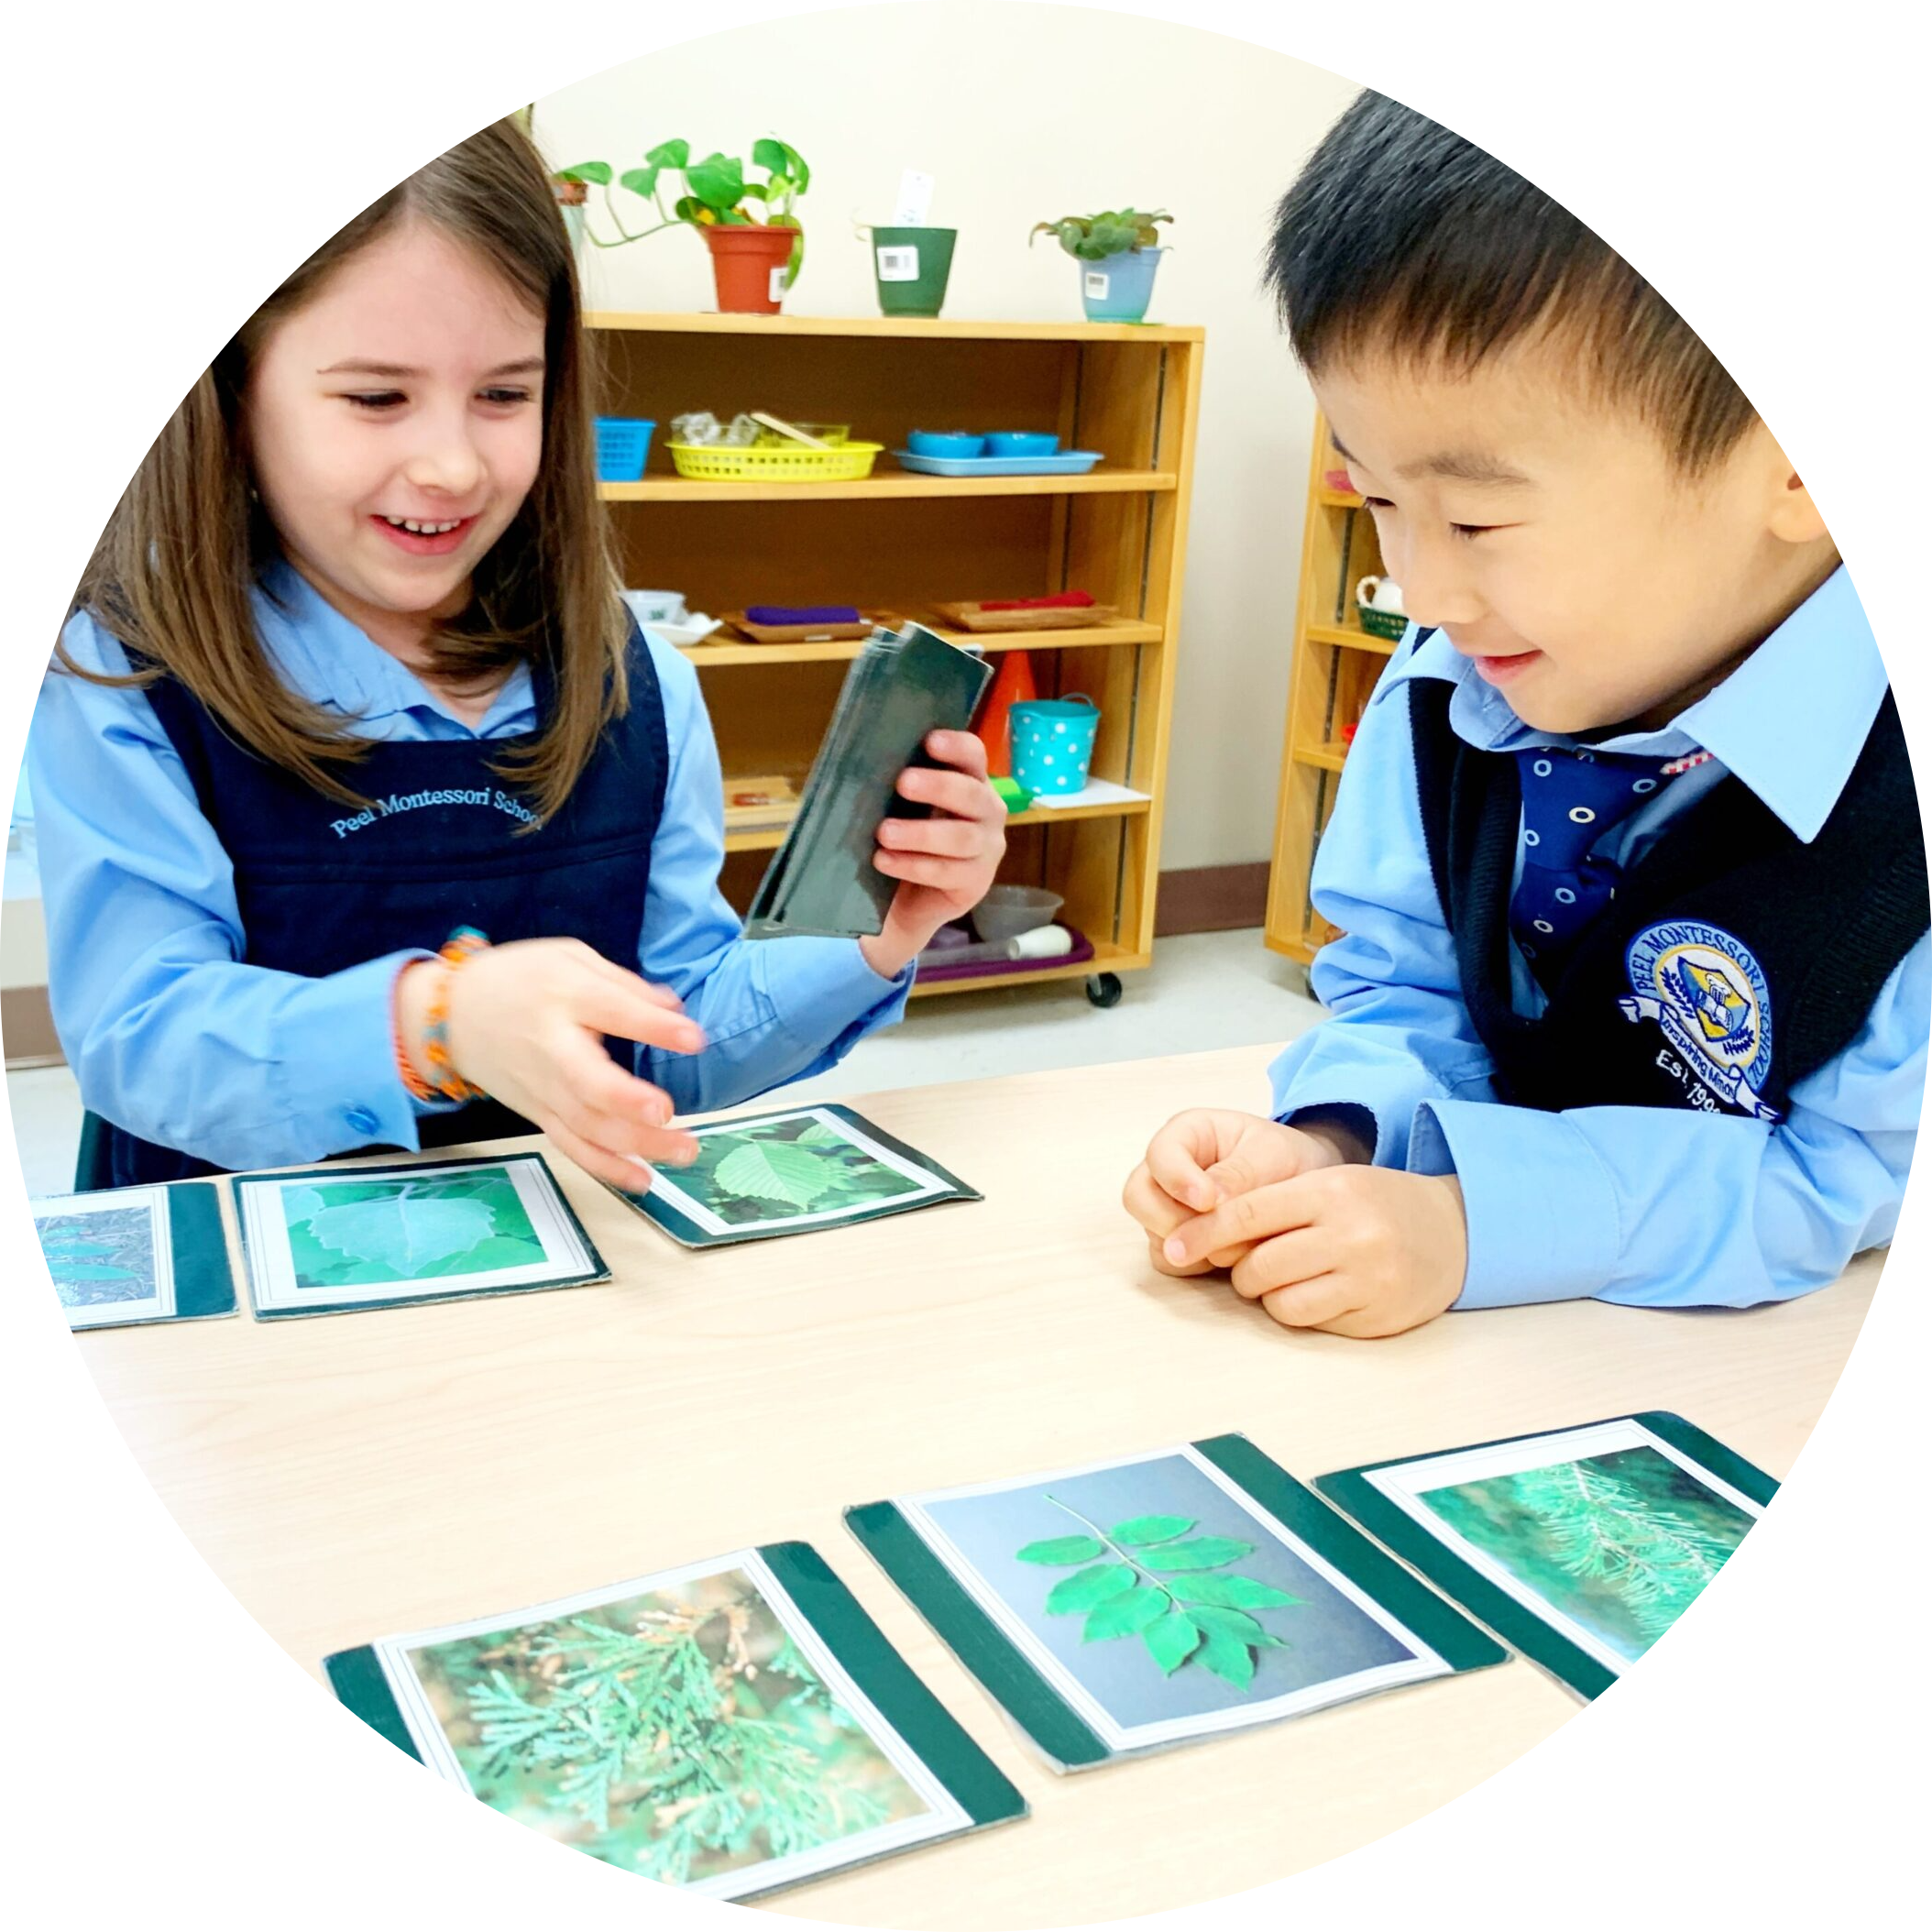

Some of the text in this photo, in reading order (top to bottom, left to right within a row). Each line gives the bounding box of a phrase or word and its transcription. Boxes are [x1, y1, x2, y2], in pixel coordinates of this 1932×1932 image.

[330, 806, 378, 839] Peel
[376, 787, 490, 817] Montessori
[1632, 925, 1770, 1084] PEEL MONTESSORI SCHOOL
[1661, 1019, 1707, 1077] Inspiring
[1686, 1082, 1721, 1114] 199
